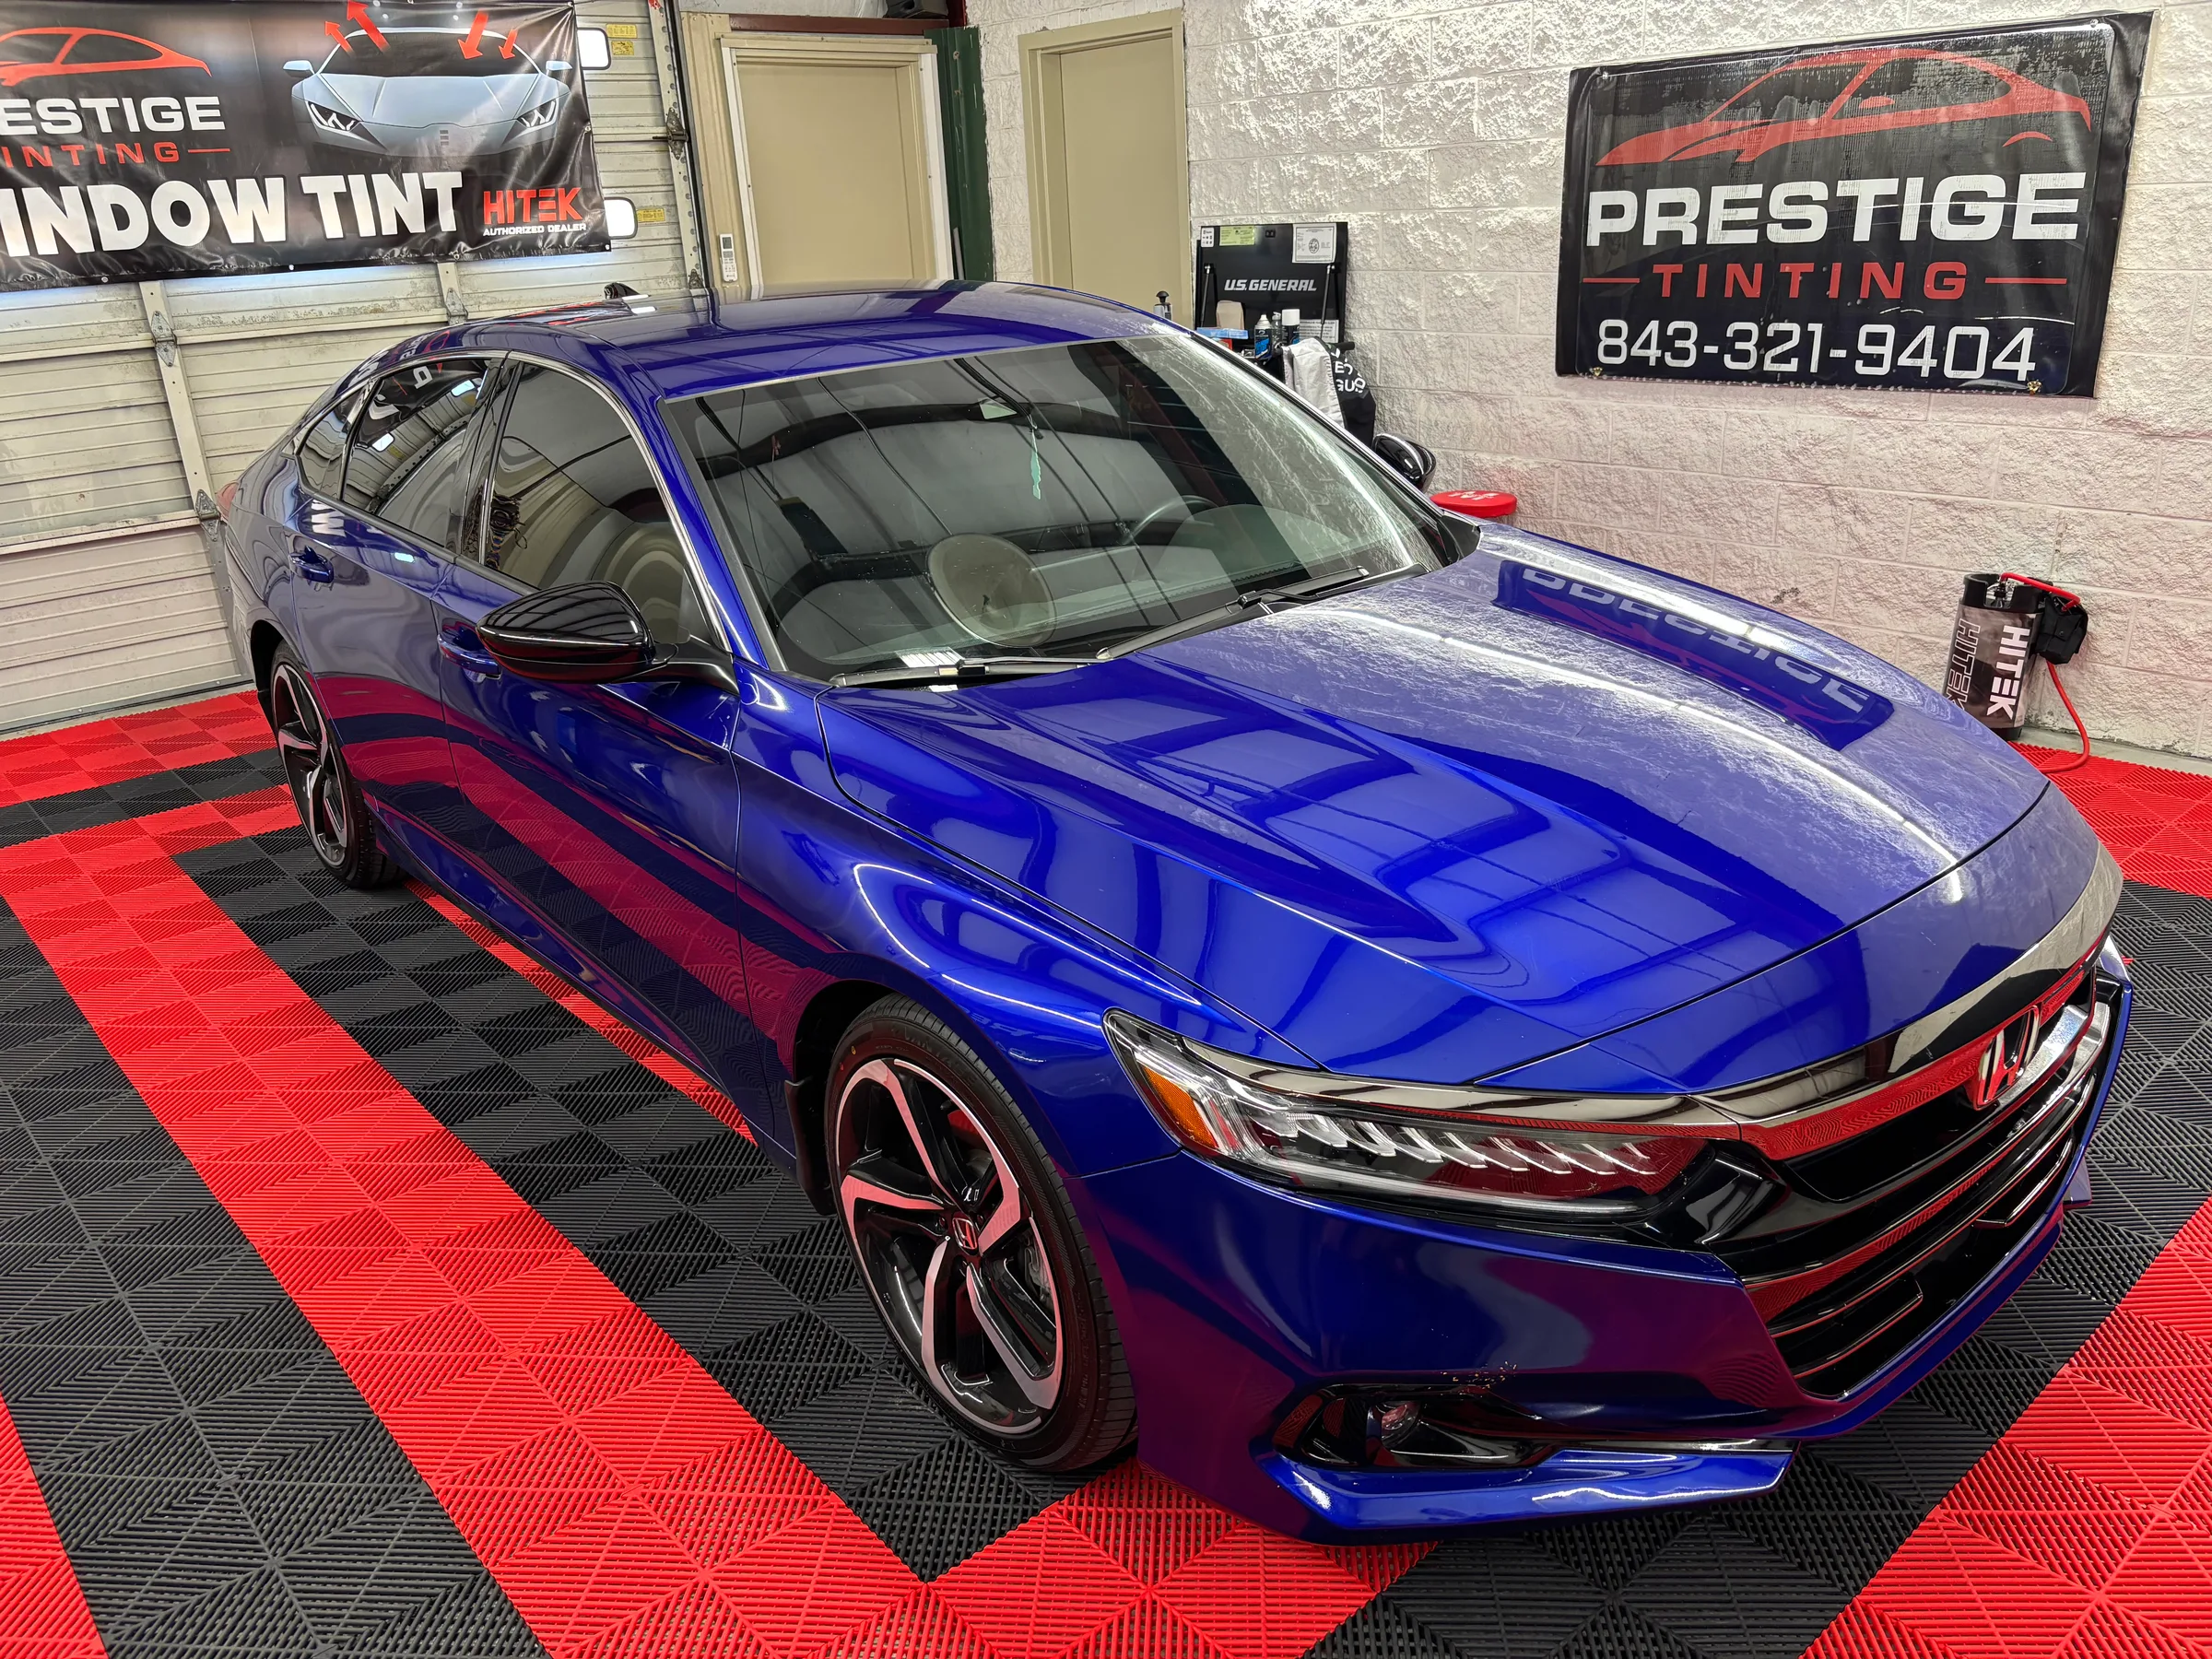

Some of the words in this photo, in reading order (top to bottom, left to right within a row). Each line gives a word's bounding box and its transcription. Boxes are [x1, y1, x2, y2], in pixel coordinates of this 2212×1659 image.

[300, 171, 463, 239] TINT
[483, 187, 583, 225] HITEK
[483, 225, 545, 237] AUTHORIZED
[547, 222, 587, 233] DEALER
[1585, 171, 2087, 247] PRESTIGE
[1248, 279, 1317, 291] GENERAL
[1653, 261, 1968, 300] TINTING
[1597, 318, 2036, 382] 843-321-9404
[1947, 618, 1980, 710] HITEK
[1987, 626, 2030, 719] HITEK
